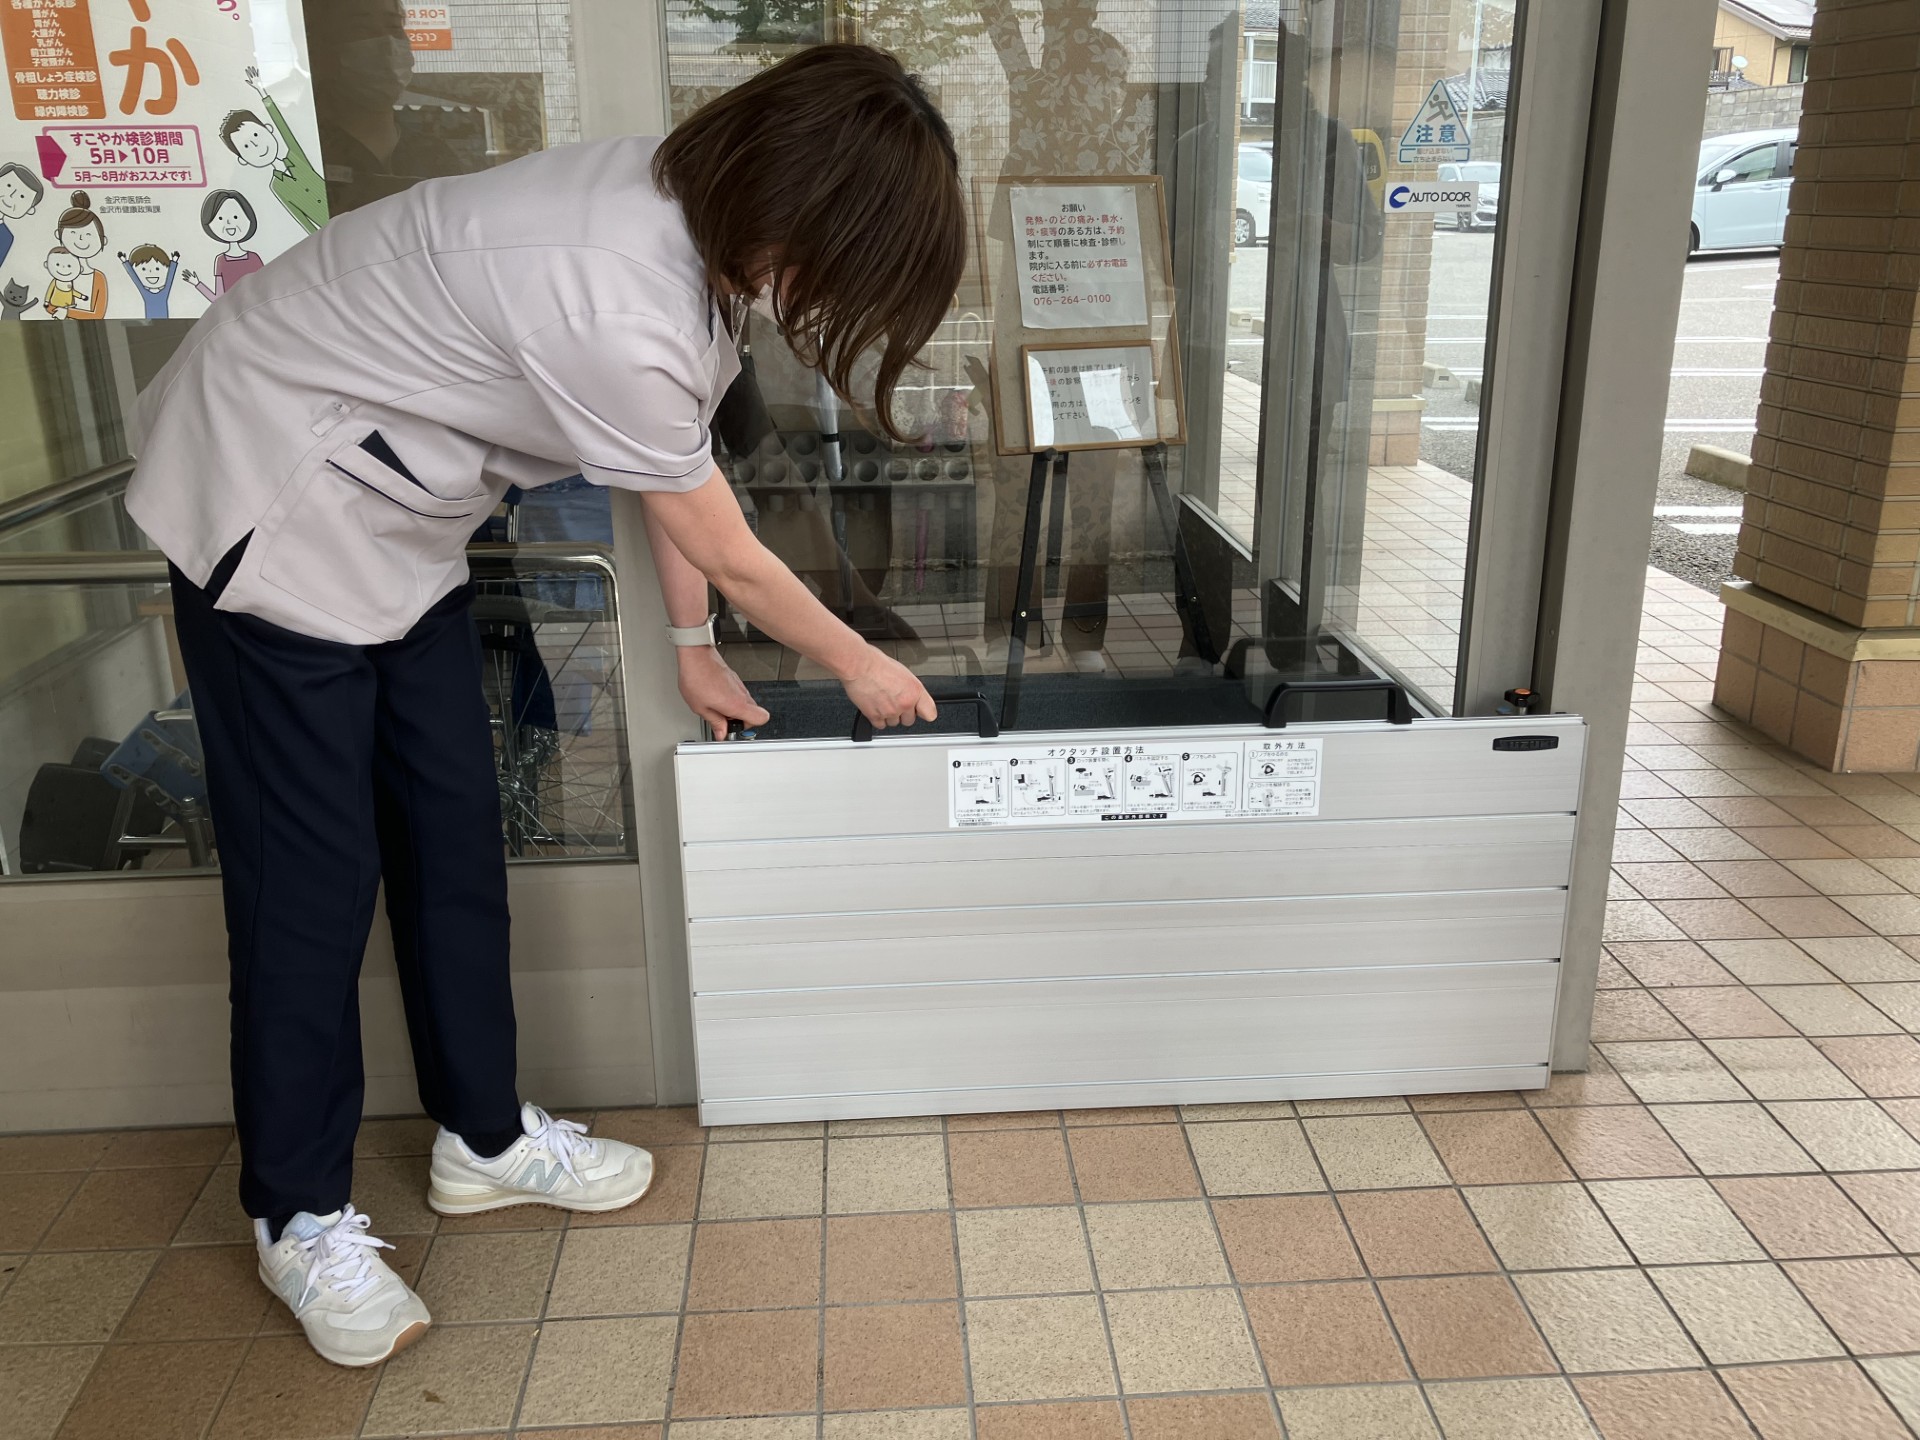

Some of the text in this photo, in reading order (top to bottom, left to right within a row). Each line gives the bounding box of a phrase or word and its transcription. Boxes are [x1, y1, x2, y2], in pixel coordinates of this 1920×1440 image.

[108, 0, 200, 116] か
[14, 71, 97, 84] 骨粗しょう症検診
[70, 131, 184, 146] すこやか検診期間
[1415, 124, 1457, 143] 注意
[104, 195, 152, 204] 金沢市医師会
[1408, 191, 1471, 203] AUTO DOOR
[1062, 204, 1086, 213] お願い
[1028, 251, 1050, 260] ます。
[1029, 258, 1129, 271] 院内に入る前に必ずお電話
[1031, 273, 1068, 282] ください。
[1047, 746, 1145, 757] オクタッチ設置方法
[1263, 742, 1306, 750] 取外方法
